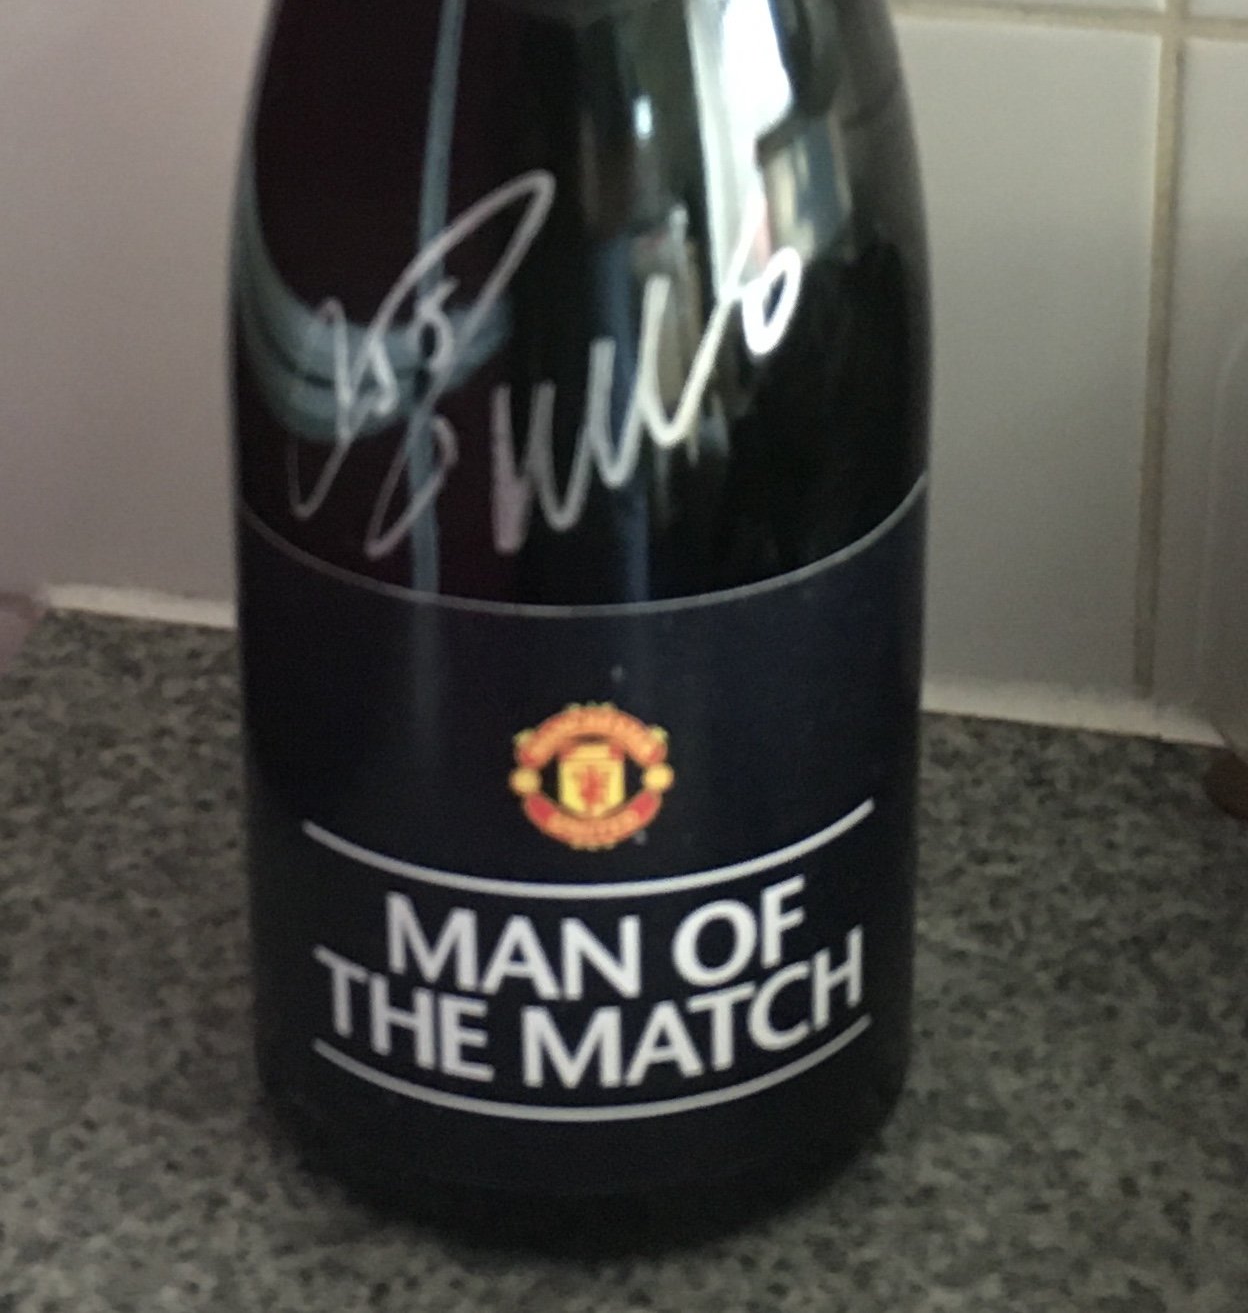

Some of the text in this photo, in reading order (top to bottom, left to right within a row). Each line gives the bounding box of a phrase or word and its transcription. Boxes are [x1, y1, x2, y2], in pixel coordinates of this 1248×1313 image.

[312, 924, 865, 1089] THE MATCH
[386, 873, 805, 1002] MAN OF
